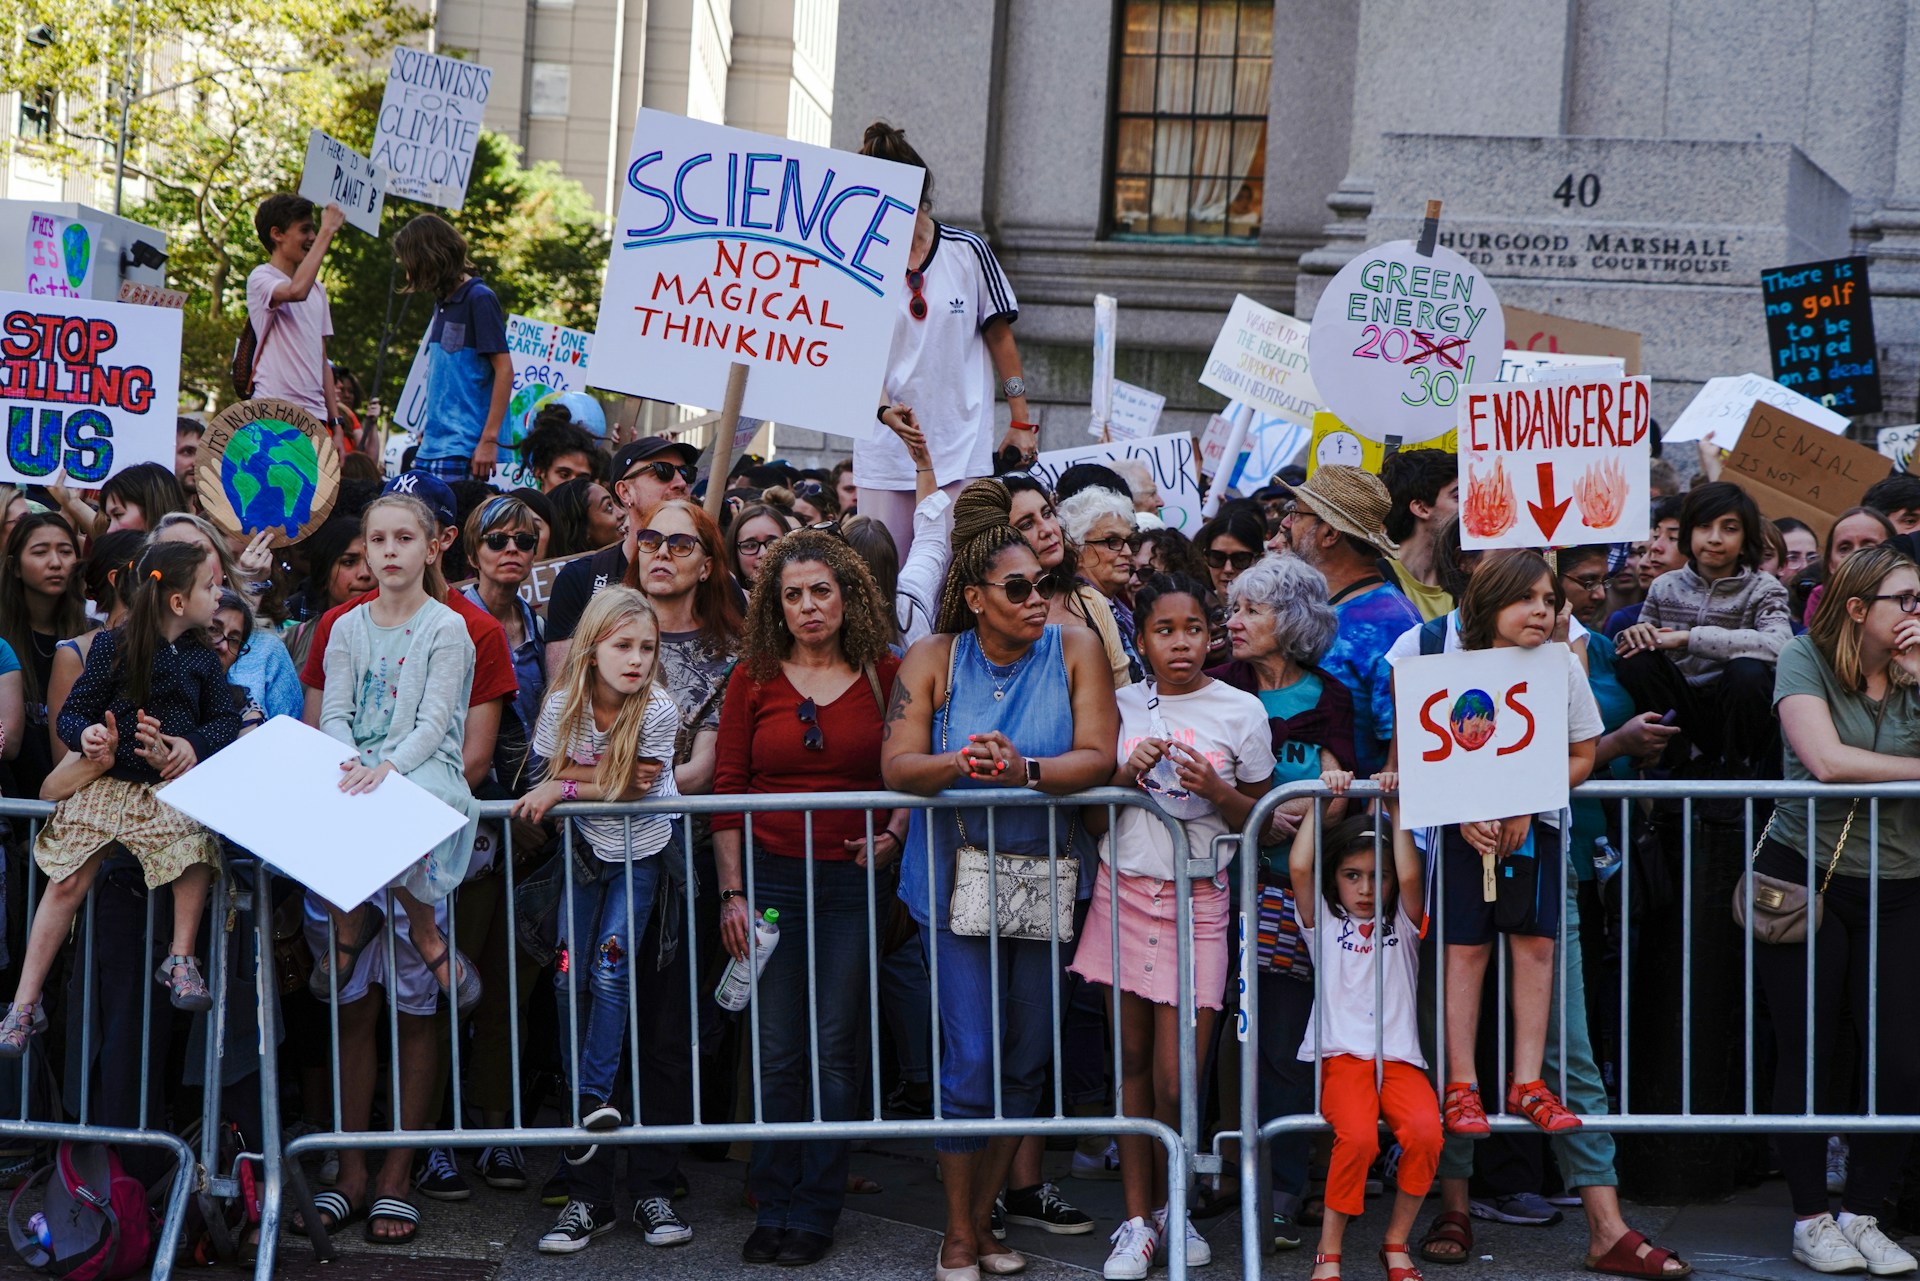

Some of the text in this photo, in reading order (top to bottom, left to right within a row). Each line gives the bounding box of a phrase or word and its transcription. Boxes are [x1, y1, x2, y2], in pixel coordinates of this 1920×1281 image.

[390, 48, 490, 104] SCIENTISTS
[404, 88, 462, 115] FOR
[380, 104, 479, 154] CLIMATE
[321, 134, 375, 178] THERE IS NO
[373, 139, 469, 189] ACTION
[330, 164, 365, 207] PLANET
[1553, 173, 1601, 208] 40
[31, 215, 54, 238] THIS
[626, 150, 916, 281] SCIENCE
[33, 240, 59, 268] IS
[713, 240, 820, 289] NOT
[1419, 231, 1731, 257] HURGOOD MARSHALL
[1506, 253, 1578, 268] STATES
[1591, 256, 1732, 273] COURTHOUSE
[1360, 259, 1475, 303] GREEN
[1761, 263, 1853, 293] There is
[1767, 281, 1855, 319] no golf
[650, 271, 844, 330] MAGICAL
[1347, 292, 1487, 339] ENERGY
[1, 310, 118, 364] STOP
[507, 335, 549, 358] EARTH
[518, 321, 543, 342] ONE
[561, 331, 587, 352] ONE
[634, 306, 829, 367] THINKING
[1246, 310, 1275, 336] WAKE
[1278, 325, 1298, 345] UP
[1352, 324, 1466, 368] 2050
[1786, 318, 1851, 340] to be
[1237, 329, 1309, 374] THE REALITY
[1237, 352, 1291, 385] SUPPORT
[1778, 359, 1873, 386] on a dead
[0, 358, 156, 415] ILLING
[1209, 360, 1322, 420] CARBON NEUTRALITY
[208, 402, 318, 455] IT'S IN OUR HANDS
[1469, 380, 1649, 451] ENDANGERED
[7, 405, 114, 483] US
[1750, 415, 1859, 483] DENIAL
[1736, 452, 1820, 499] IS NOT A
[1419, 681, 1535, 762] SOS
